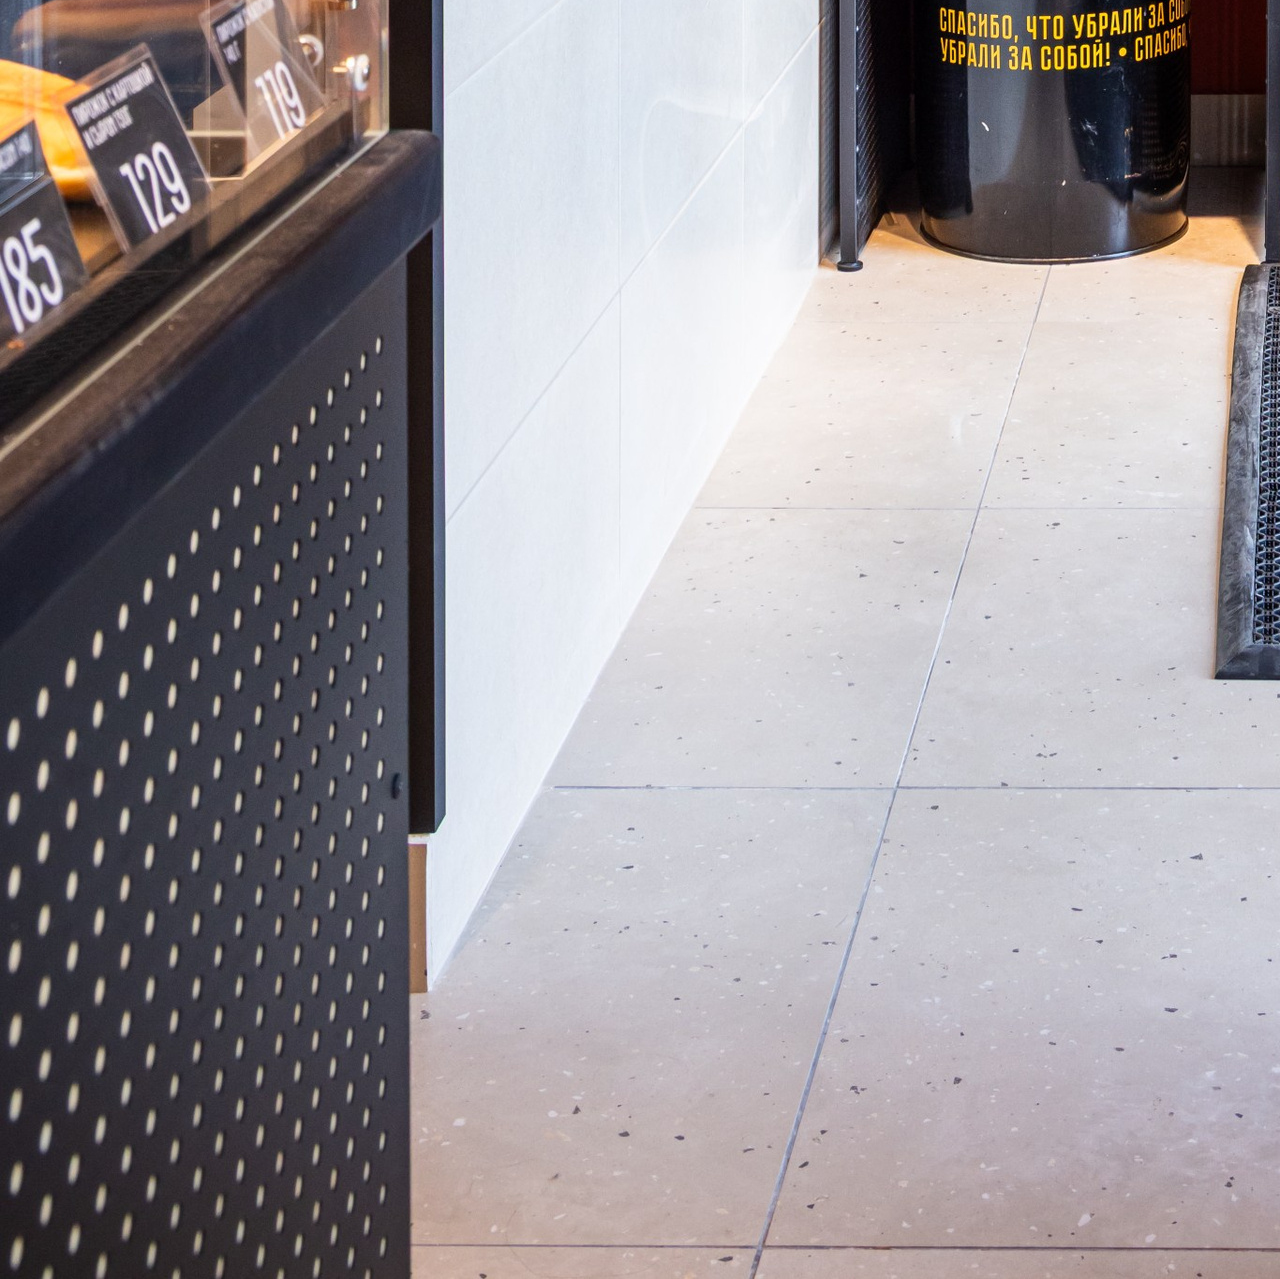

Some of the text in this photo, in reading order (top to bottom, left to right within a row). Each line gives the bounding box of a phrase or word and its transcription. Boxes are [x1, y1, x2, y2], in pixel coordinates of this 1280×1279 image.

[939, 6, 1019, 43] СПАСИБО,
[1026, 14, 1065, 40] ЧТО
[1073, 6, 1143, 40] УБРАЛИ
[1148, 2, 1165, 29] ЗА
[940, 37, 1001, 70] УБРАЛИ
[1008, 44, 1033, 71] ЗА
[1040, 38, 1111, 71] СОБОЙ!
[254, 61, 306, 140] 119
[119, 141, 191, 234] 129
[0, 217, 63, 334] 185
